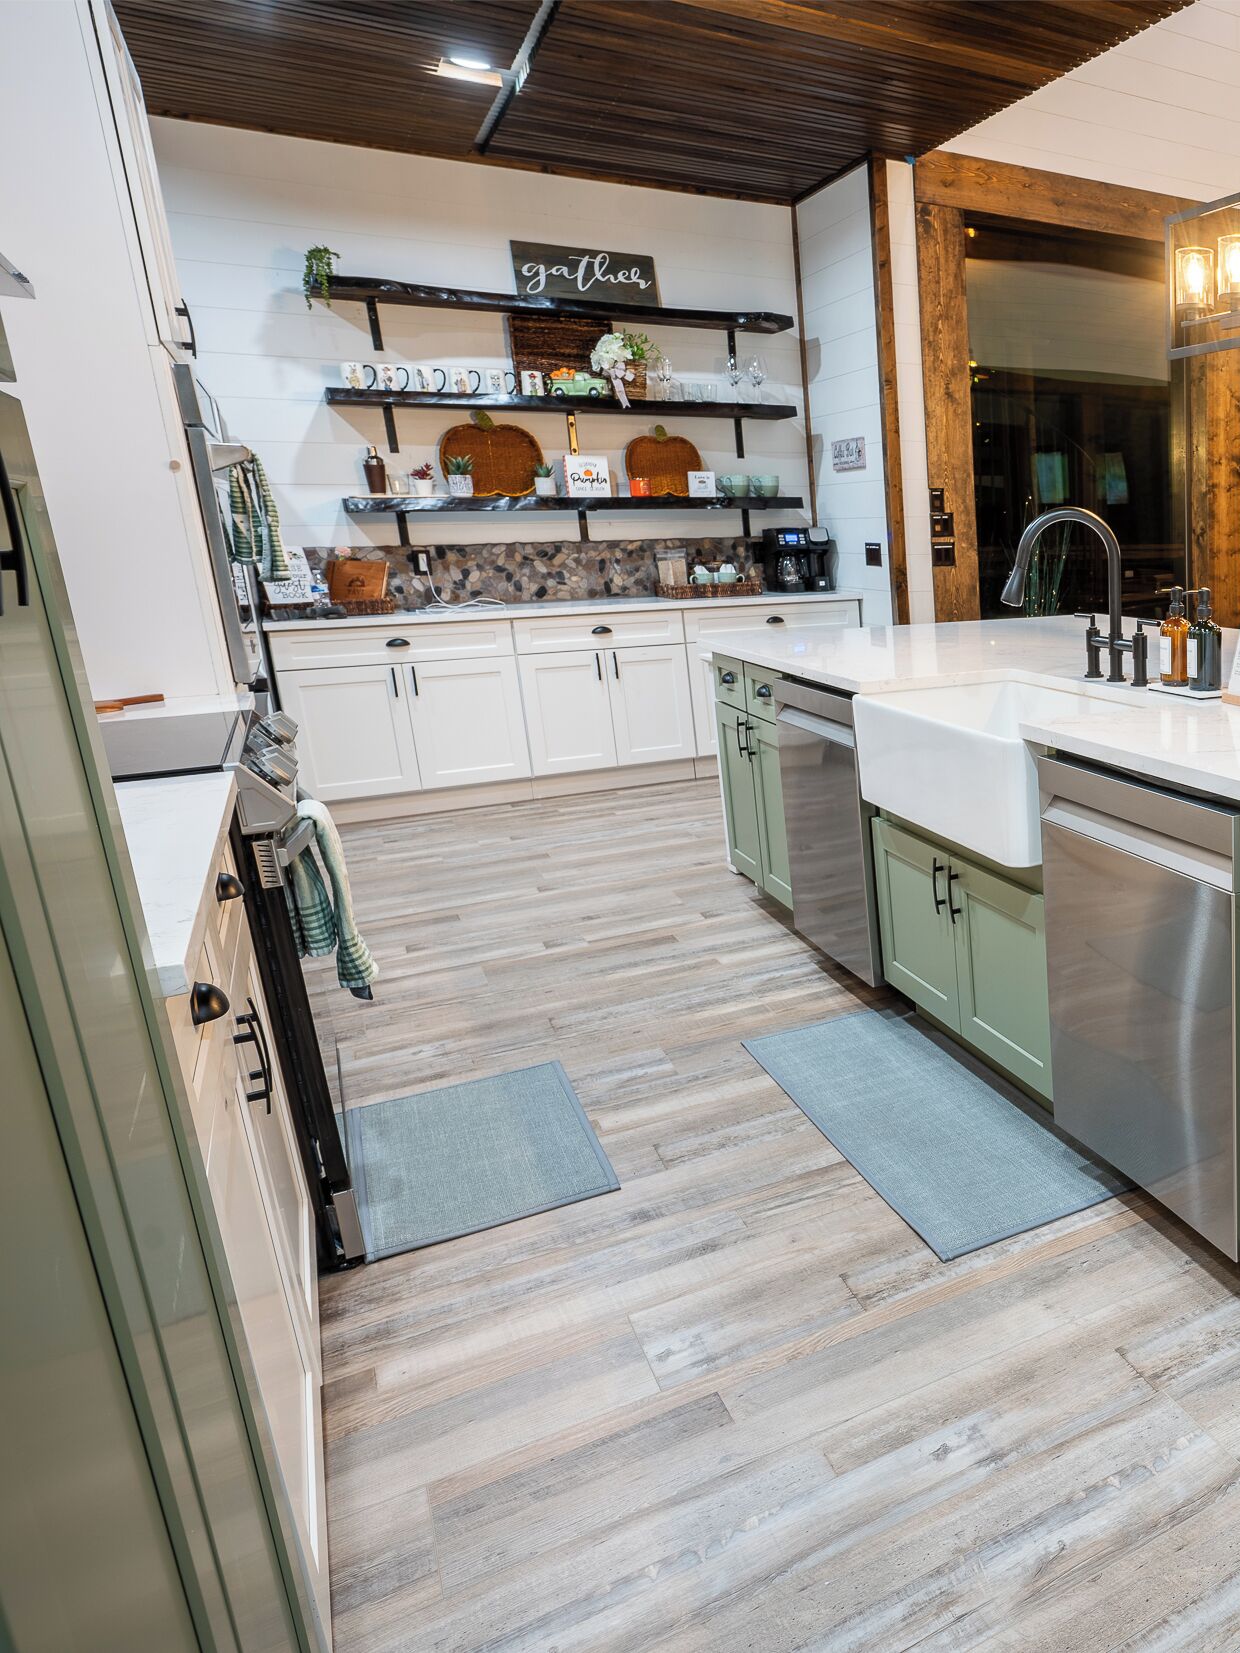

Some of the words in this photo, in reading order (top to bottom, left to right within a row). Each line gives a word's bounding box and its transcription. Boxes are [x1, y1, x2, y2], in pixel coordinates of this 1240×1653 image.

[521, 252, 652, 294] gather
[570, 472, 607, 488] Pumpkin
[273, 579, 305, 594] guest
